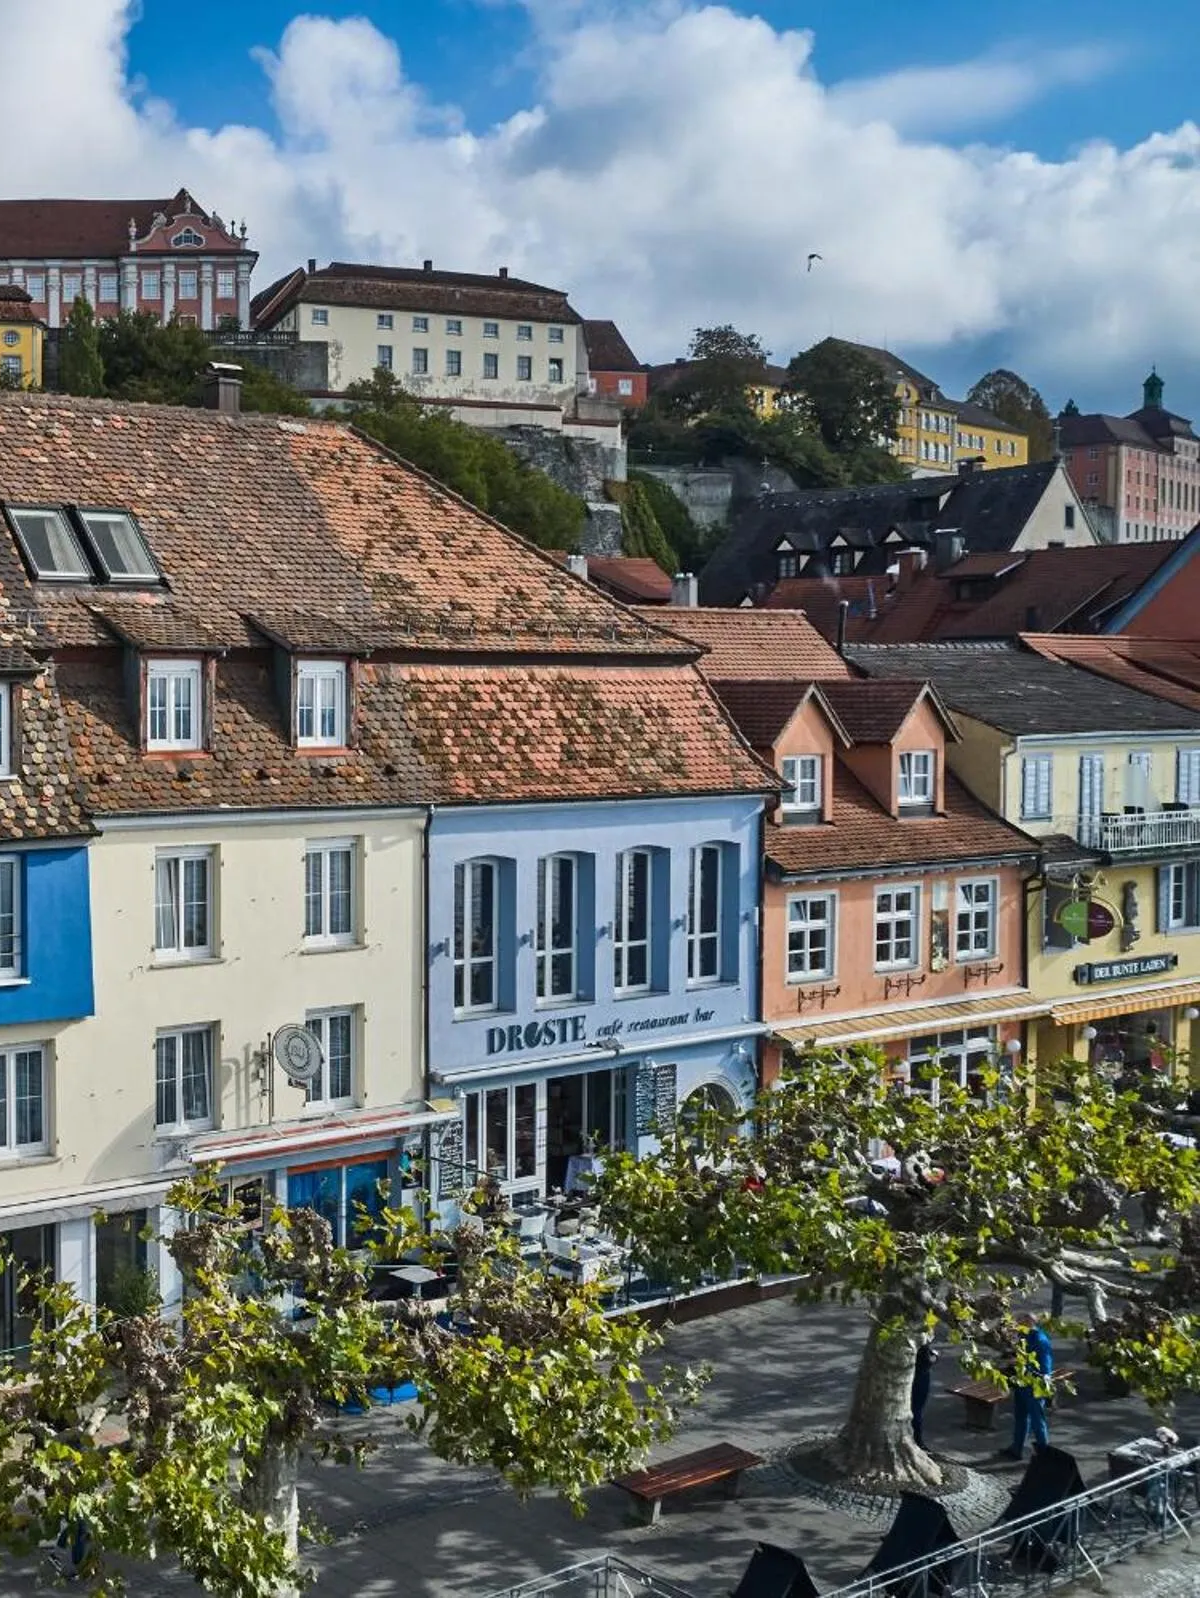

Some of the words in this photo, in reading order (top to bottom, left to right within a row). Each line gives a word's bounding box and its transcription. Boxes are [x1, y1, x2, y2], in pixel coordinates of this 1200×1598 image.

[486, 1014, 586, 1056] DROSTE
[627, 1012, 690, 1032] restaurant
[693, 1006, 716, 1025] bar
